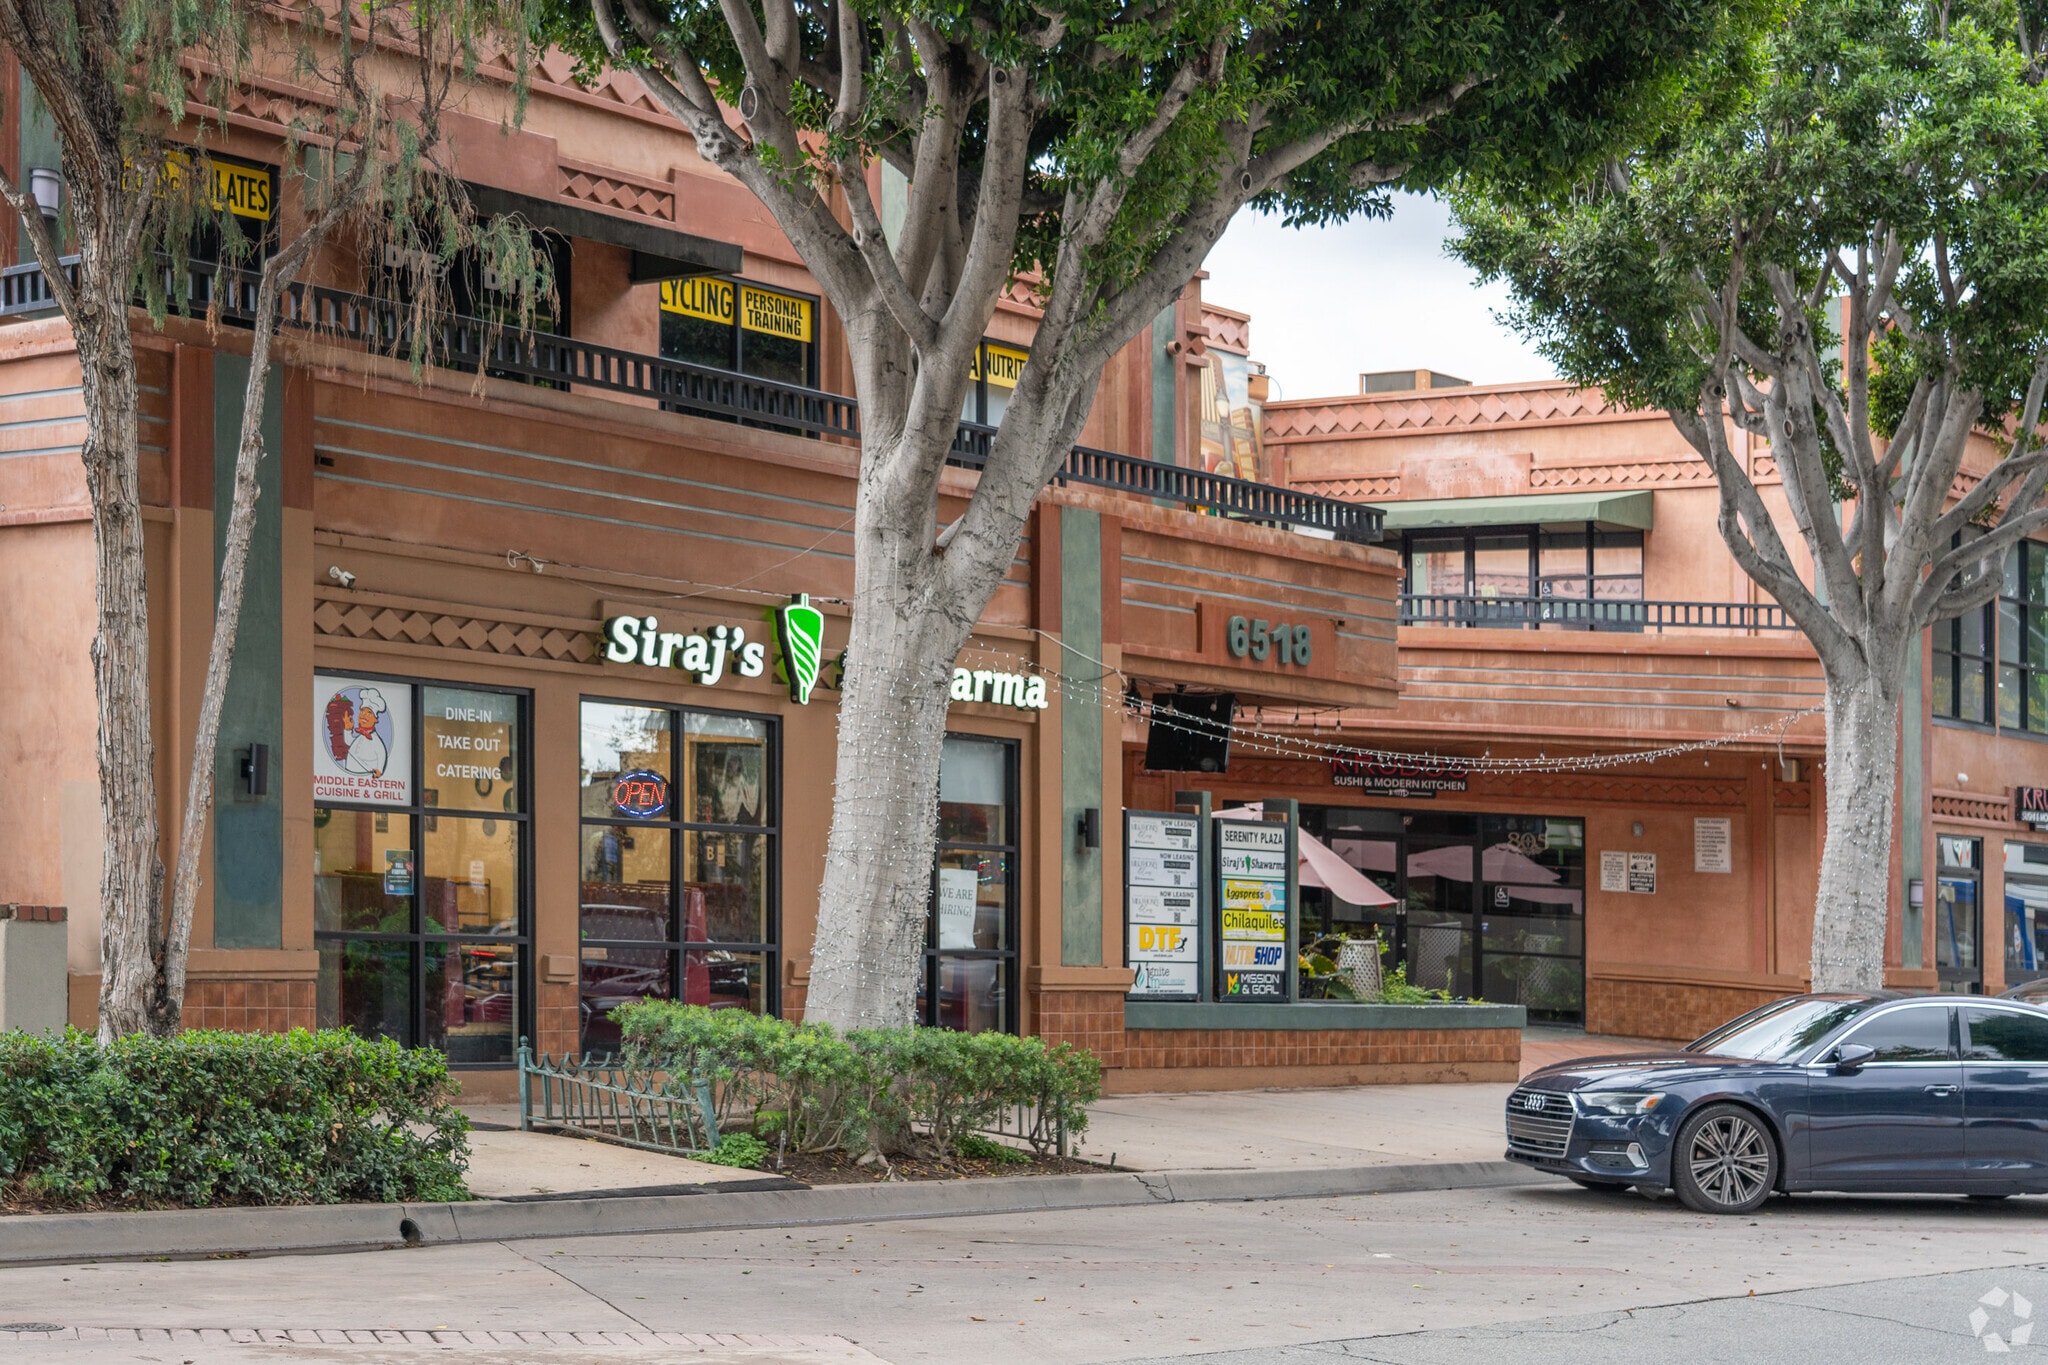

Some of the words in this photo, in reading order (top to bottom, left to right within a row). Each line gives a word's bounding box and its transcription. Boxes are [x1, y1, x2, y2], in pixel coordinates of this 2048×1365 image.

[746, 291, 803, 319] PERSONAL
[748, 309, 802, 337] TRAINING
[987, 351, 1026, 380] NUTRIT
[1227, 615, 1312, 666] 6518
[606, 615, 765, 686] Siraj's
[950, 667, 1049, 709] arma
[445, 707, 492, 723] DINE-IN
[437, 734, 471, 750] TAKE
[474, 737, 501, 752] OUT
[437, 763, 501, 780] CATERING
[314, 775, 355, 787] MIDDLE
[358, 778, 406, 790] EASTERN
[1334, 776, 1363, 786] SUSHI
[1364, 777, 1372, 787] &
[1374, 778, 1420, 789] MODERN
[1421, 780, 1466, 791] KITCHEN
[315, 787, 360, 799] CUISINE
[363, 789, 371, 798] &
[374, 790, 404, 801] GRILL
[614, 782, 666, 806] OPEN
[1225, 830, 1258, 843] SERENITY
[1260, 832, 1283, 845] PLAZA
[1222, 857, 1245, 870] Siraj's
[955, 888, 974, 900] ARE
[1224, 913, 1286, 931] Chilaquiles
[1139, 926, 1182, 951] DTF
[1240, 973, 1280, 984] MISSION
[1242, 984, 1250, 995] &
[1252, 985, 1280, 995] GOAL
